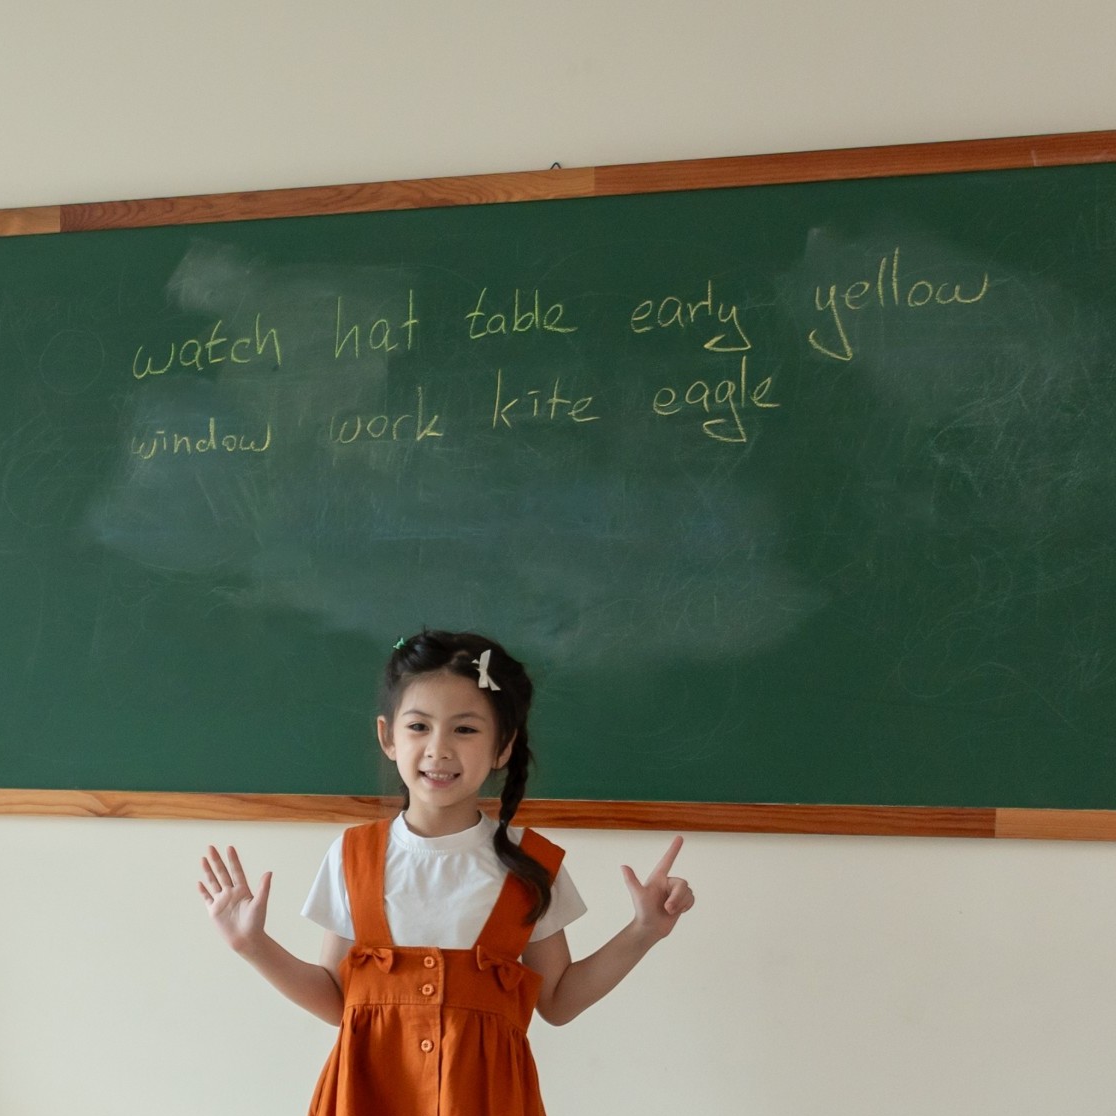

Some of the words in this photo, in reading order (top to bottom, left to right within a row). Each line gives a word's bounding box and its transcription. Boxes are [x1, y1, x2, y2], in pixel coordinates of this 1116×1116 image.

[132, 313, 281, 379] watch
[335, 289, 419, 358] hat
[465, 287, 578, 339] table
[631, 279, 751, 352] early
[809, 247, 989, 361] yellow
[131, 417, 271, 460] window
[330, 386, 443, 444] work
[492, 368, 600, 429] kite
[652, 355, 780, 443] eagle
